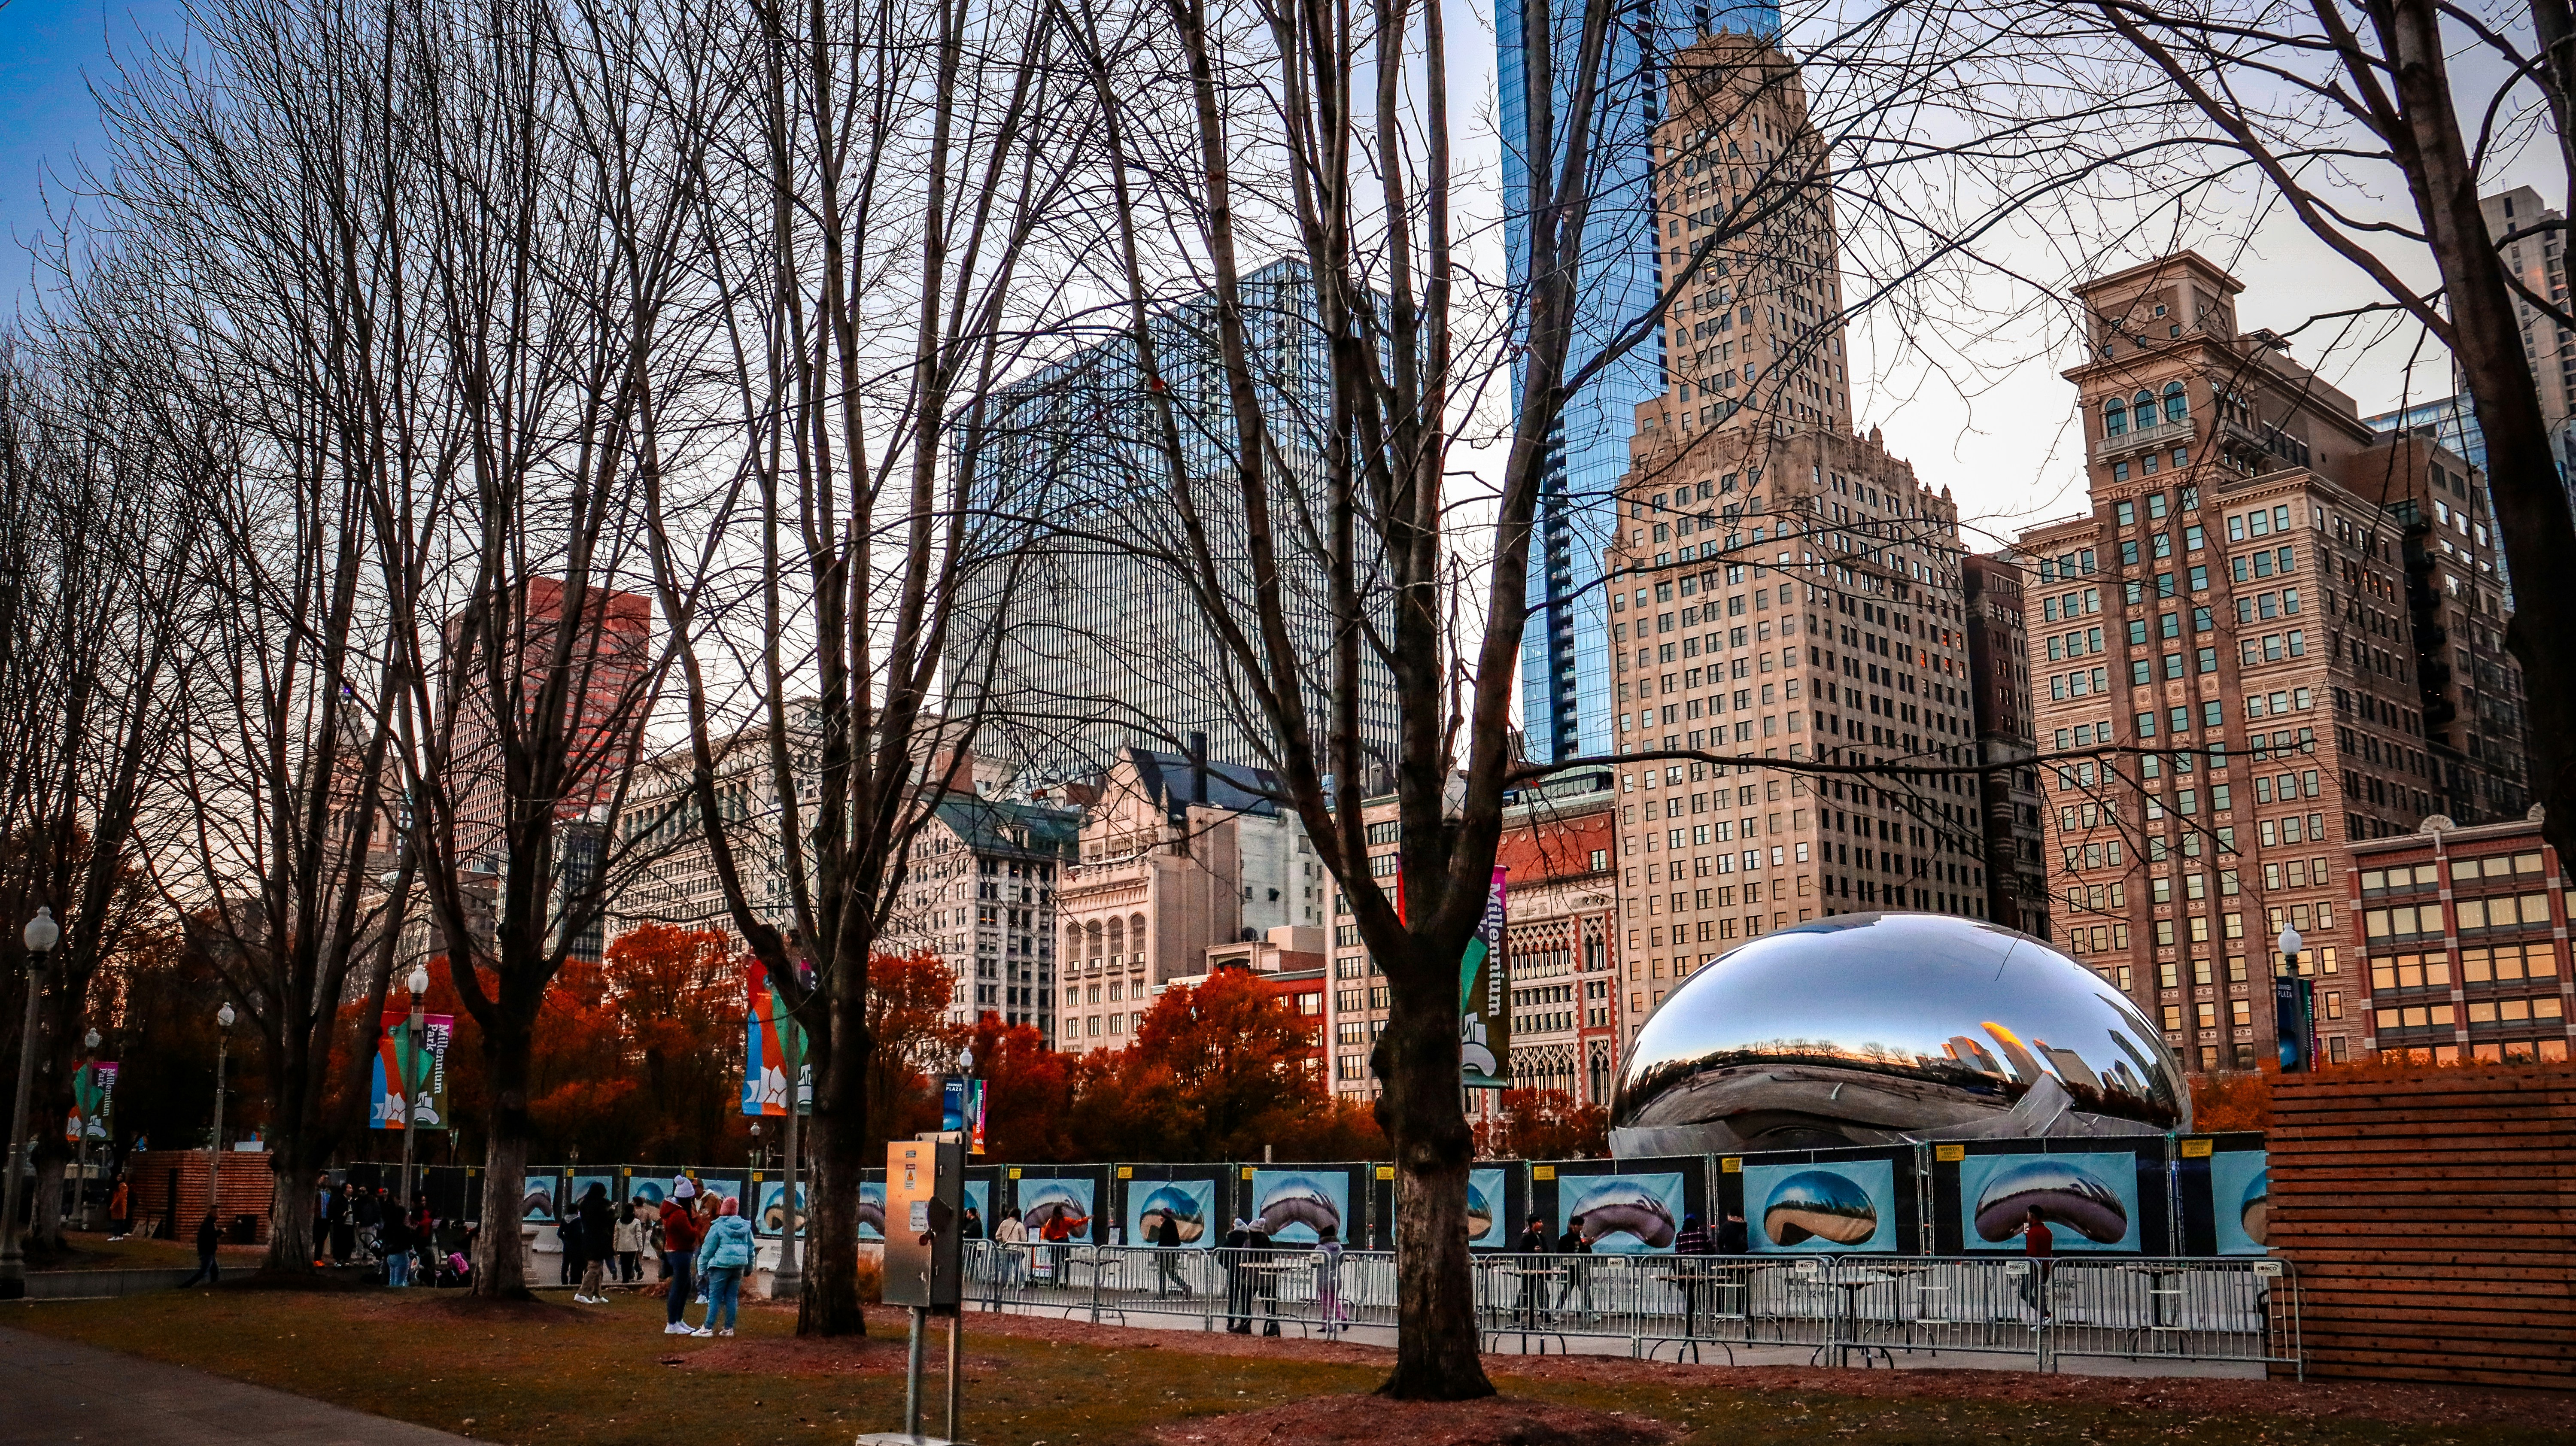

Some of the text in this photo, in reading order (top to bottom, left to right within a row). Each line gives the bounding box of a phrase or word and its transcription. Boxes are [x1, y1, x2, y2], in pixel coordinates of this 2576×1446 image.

[1488, 883, 1505, 1017] Millennium
[426, 1024, 438, 1051] Park
[434, 1024, 450, 1094] Millennium
[98, 1068, 107, 1087] Park
[103, 1068, 115, 1116] Millennium
